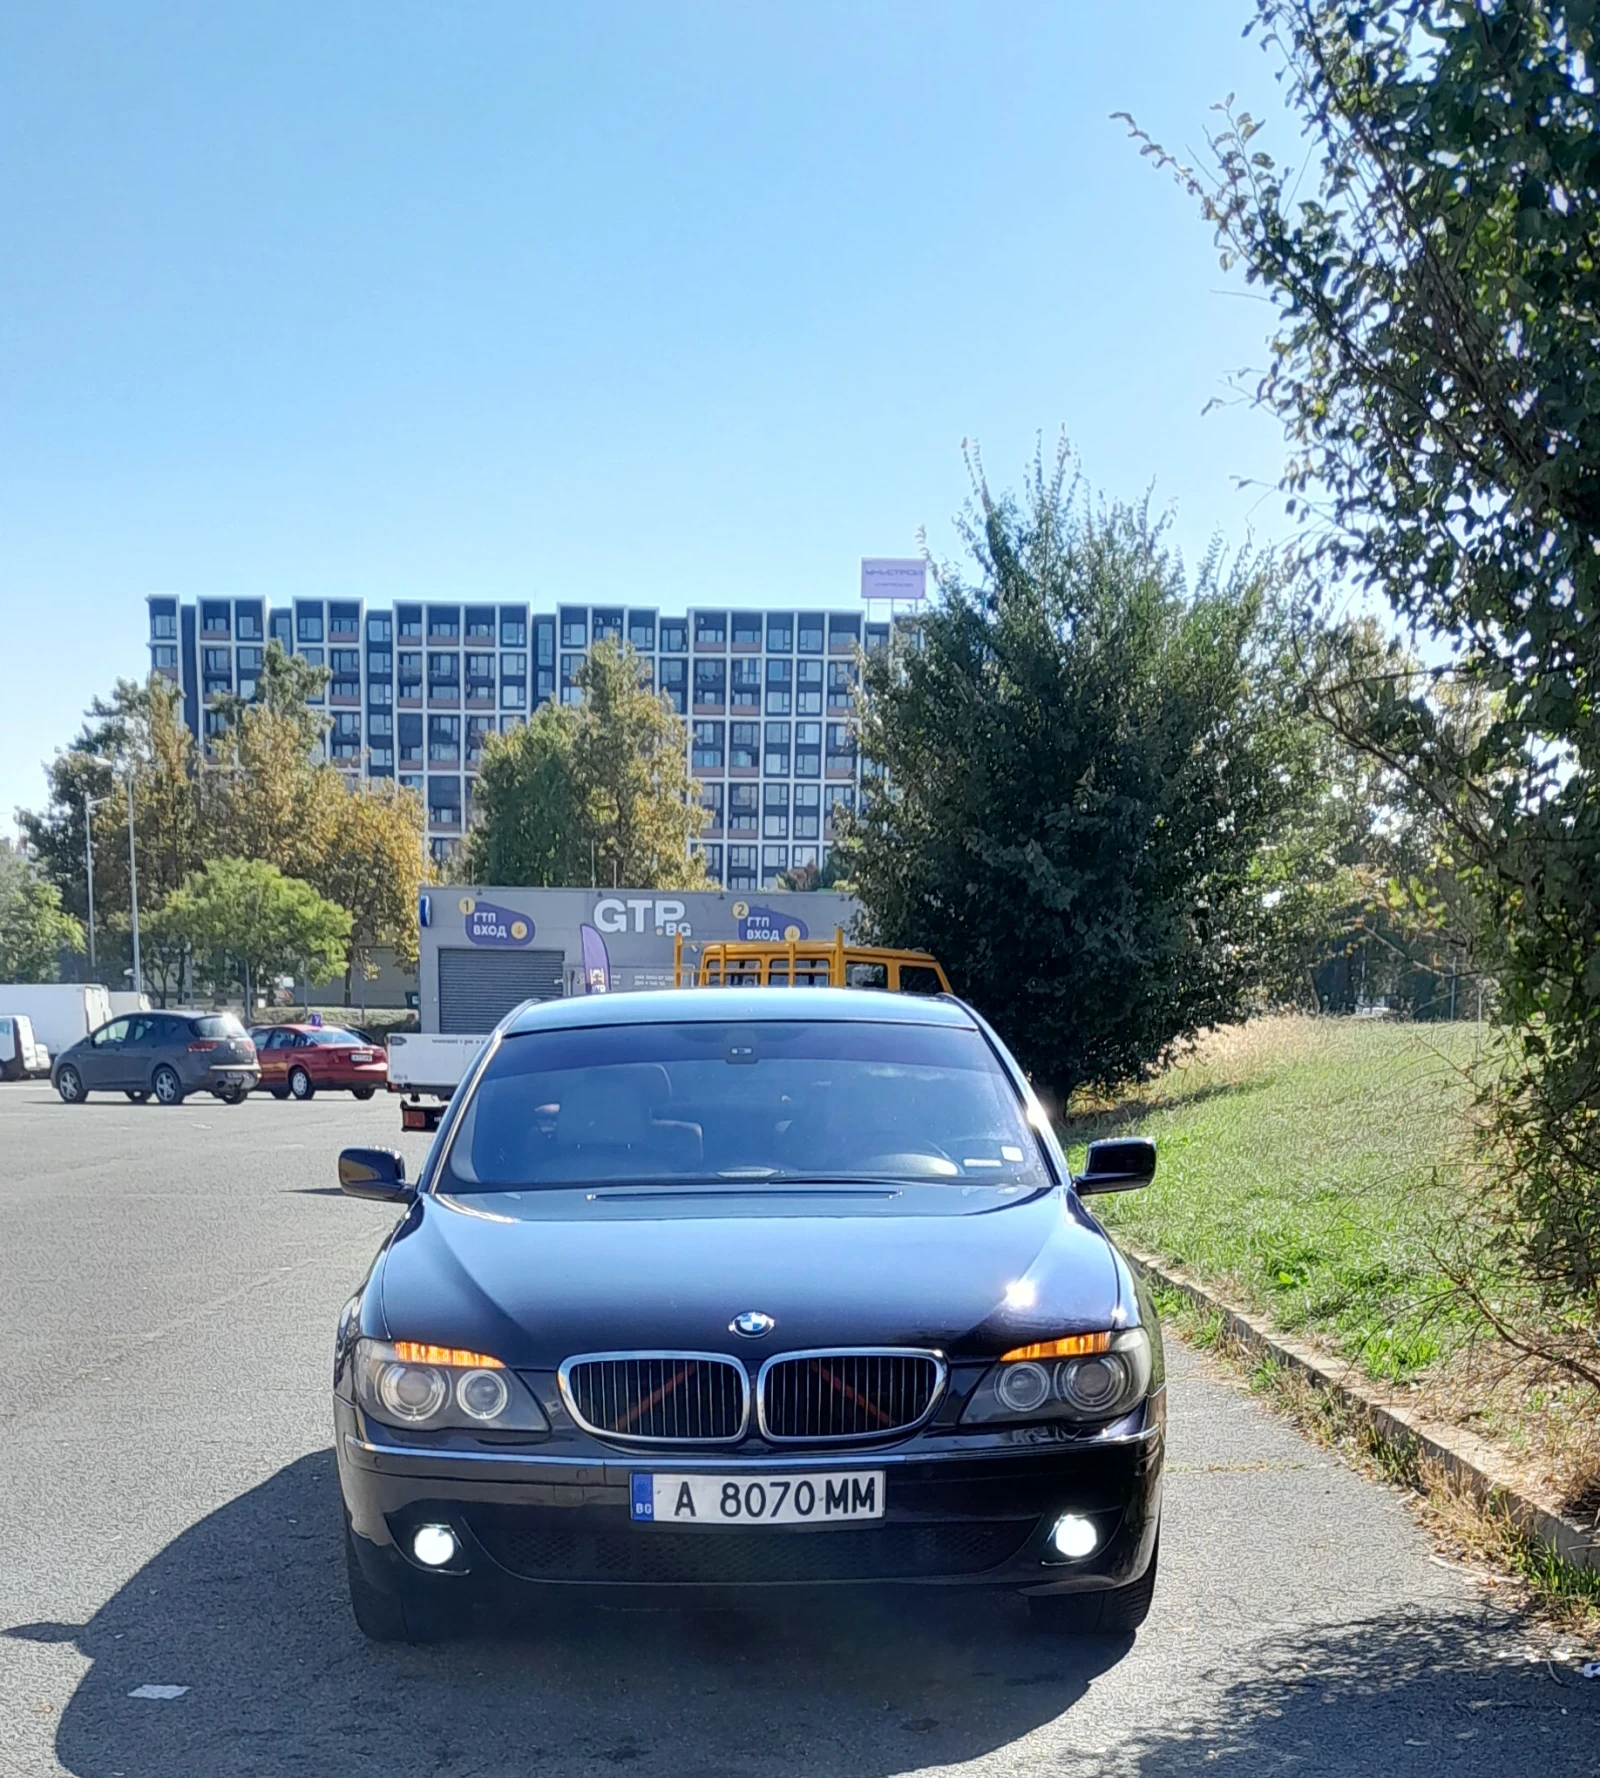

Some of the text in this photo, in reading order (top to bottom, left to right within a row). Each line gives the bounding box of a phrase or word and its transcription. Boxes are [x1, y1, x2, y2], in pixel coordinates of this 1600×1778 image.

[593, 898, 685, 933] GTP
[737, 904, 745, 916] 2
[473, 912, 496, 923] ГТП
[747, 916, 770, 927] ГТП
[473, 925, 507, 938] ВХОД
[746, 929, 780, 942] ВХОД
[674, 1477, 875, 1518] A 8070 MM
[635, 1502, 652, 1514] BG
